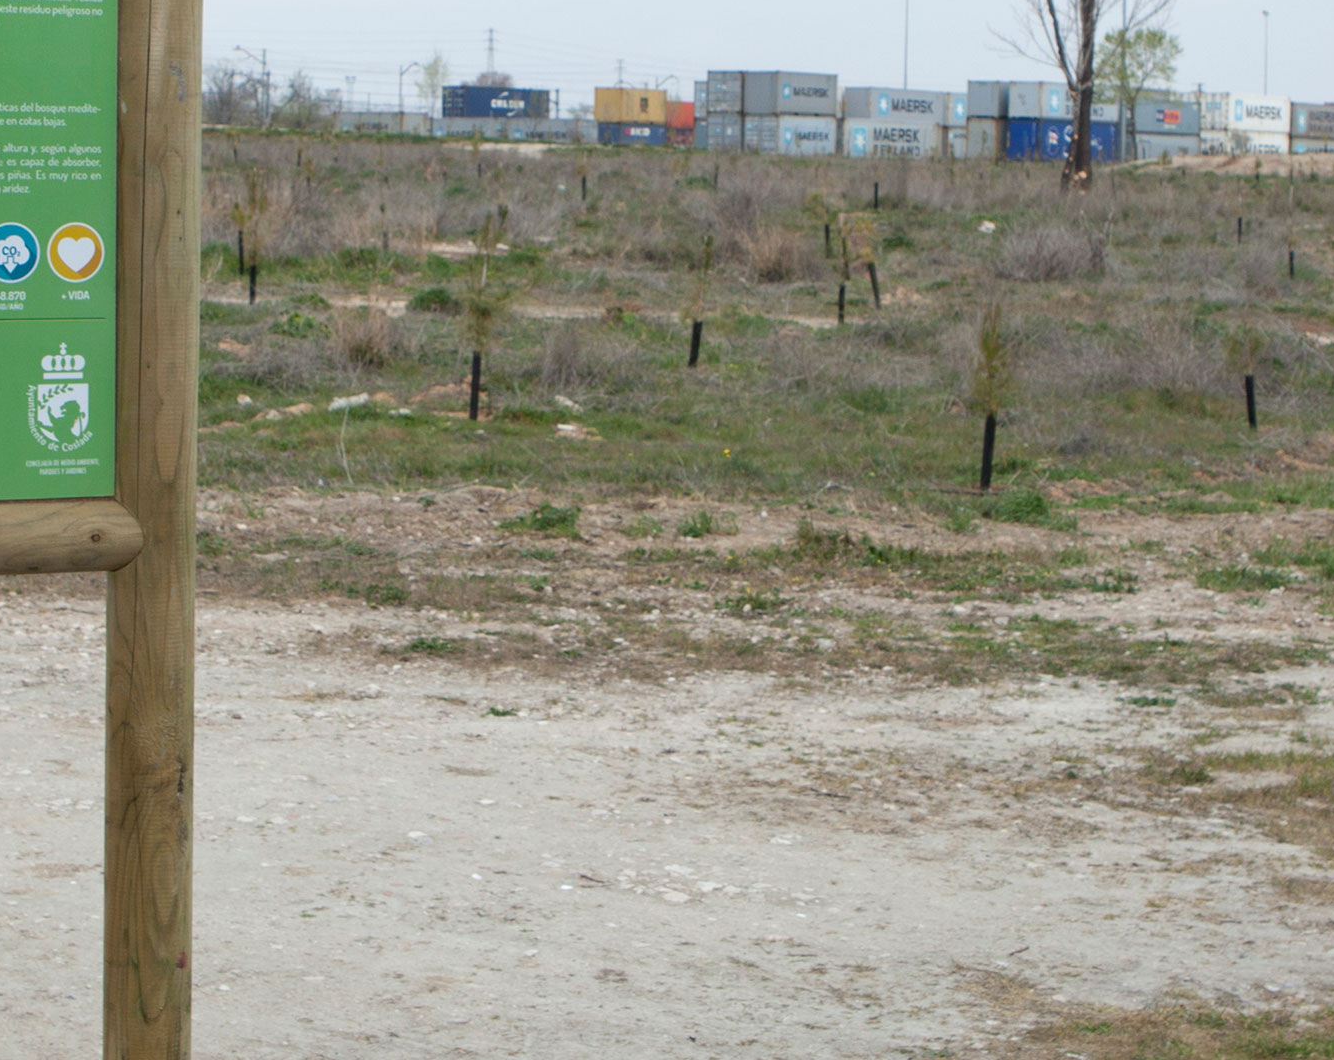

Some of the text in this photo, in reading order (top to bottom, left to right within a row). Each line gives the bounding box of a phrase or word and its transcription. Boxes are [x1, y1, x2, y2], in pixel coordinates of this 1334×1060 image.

[793, 87, 829, 97] MAERSK
[891, 98, 933, 114] MAERSK
[1246, 104, 1283, 120] MAERSK
[873, 127, 921, 142] MAERSK
[67, 290, 90, 300] VIDA
[25, 384, 93, 452] Ayuntamiento de Coslada
